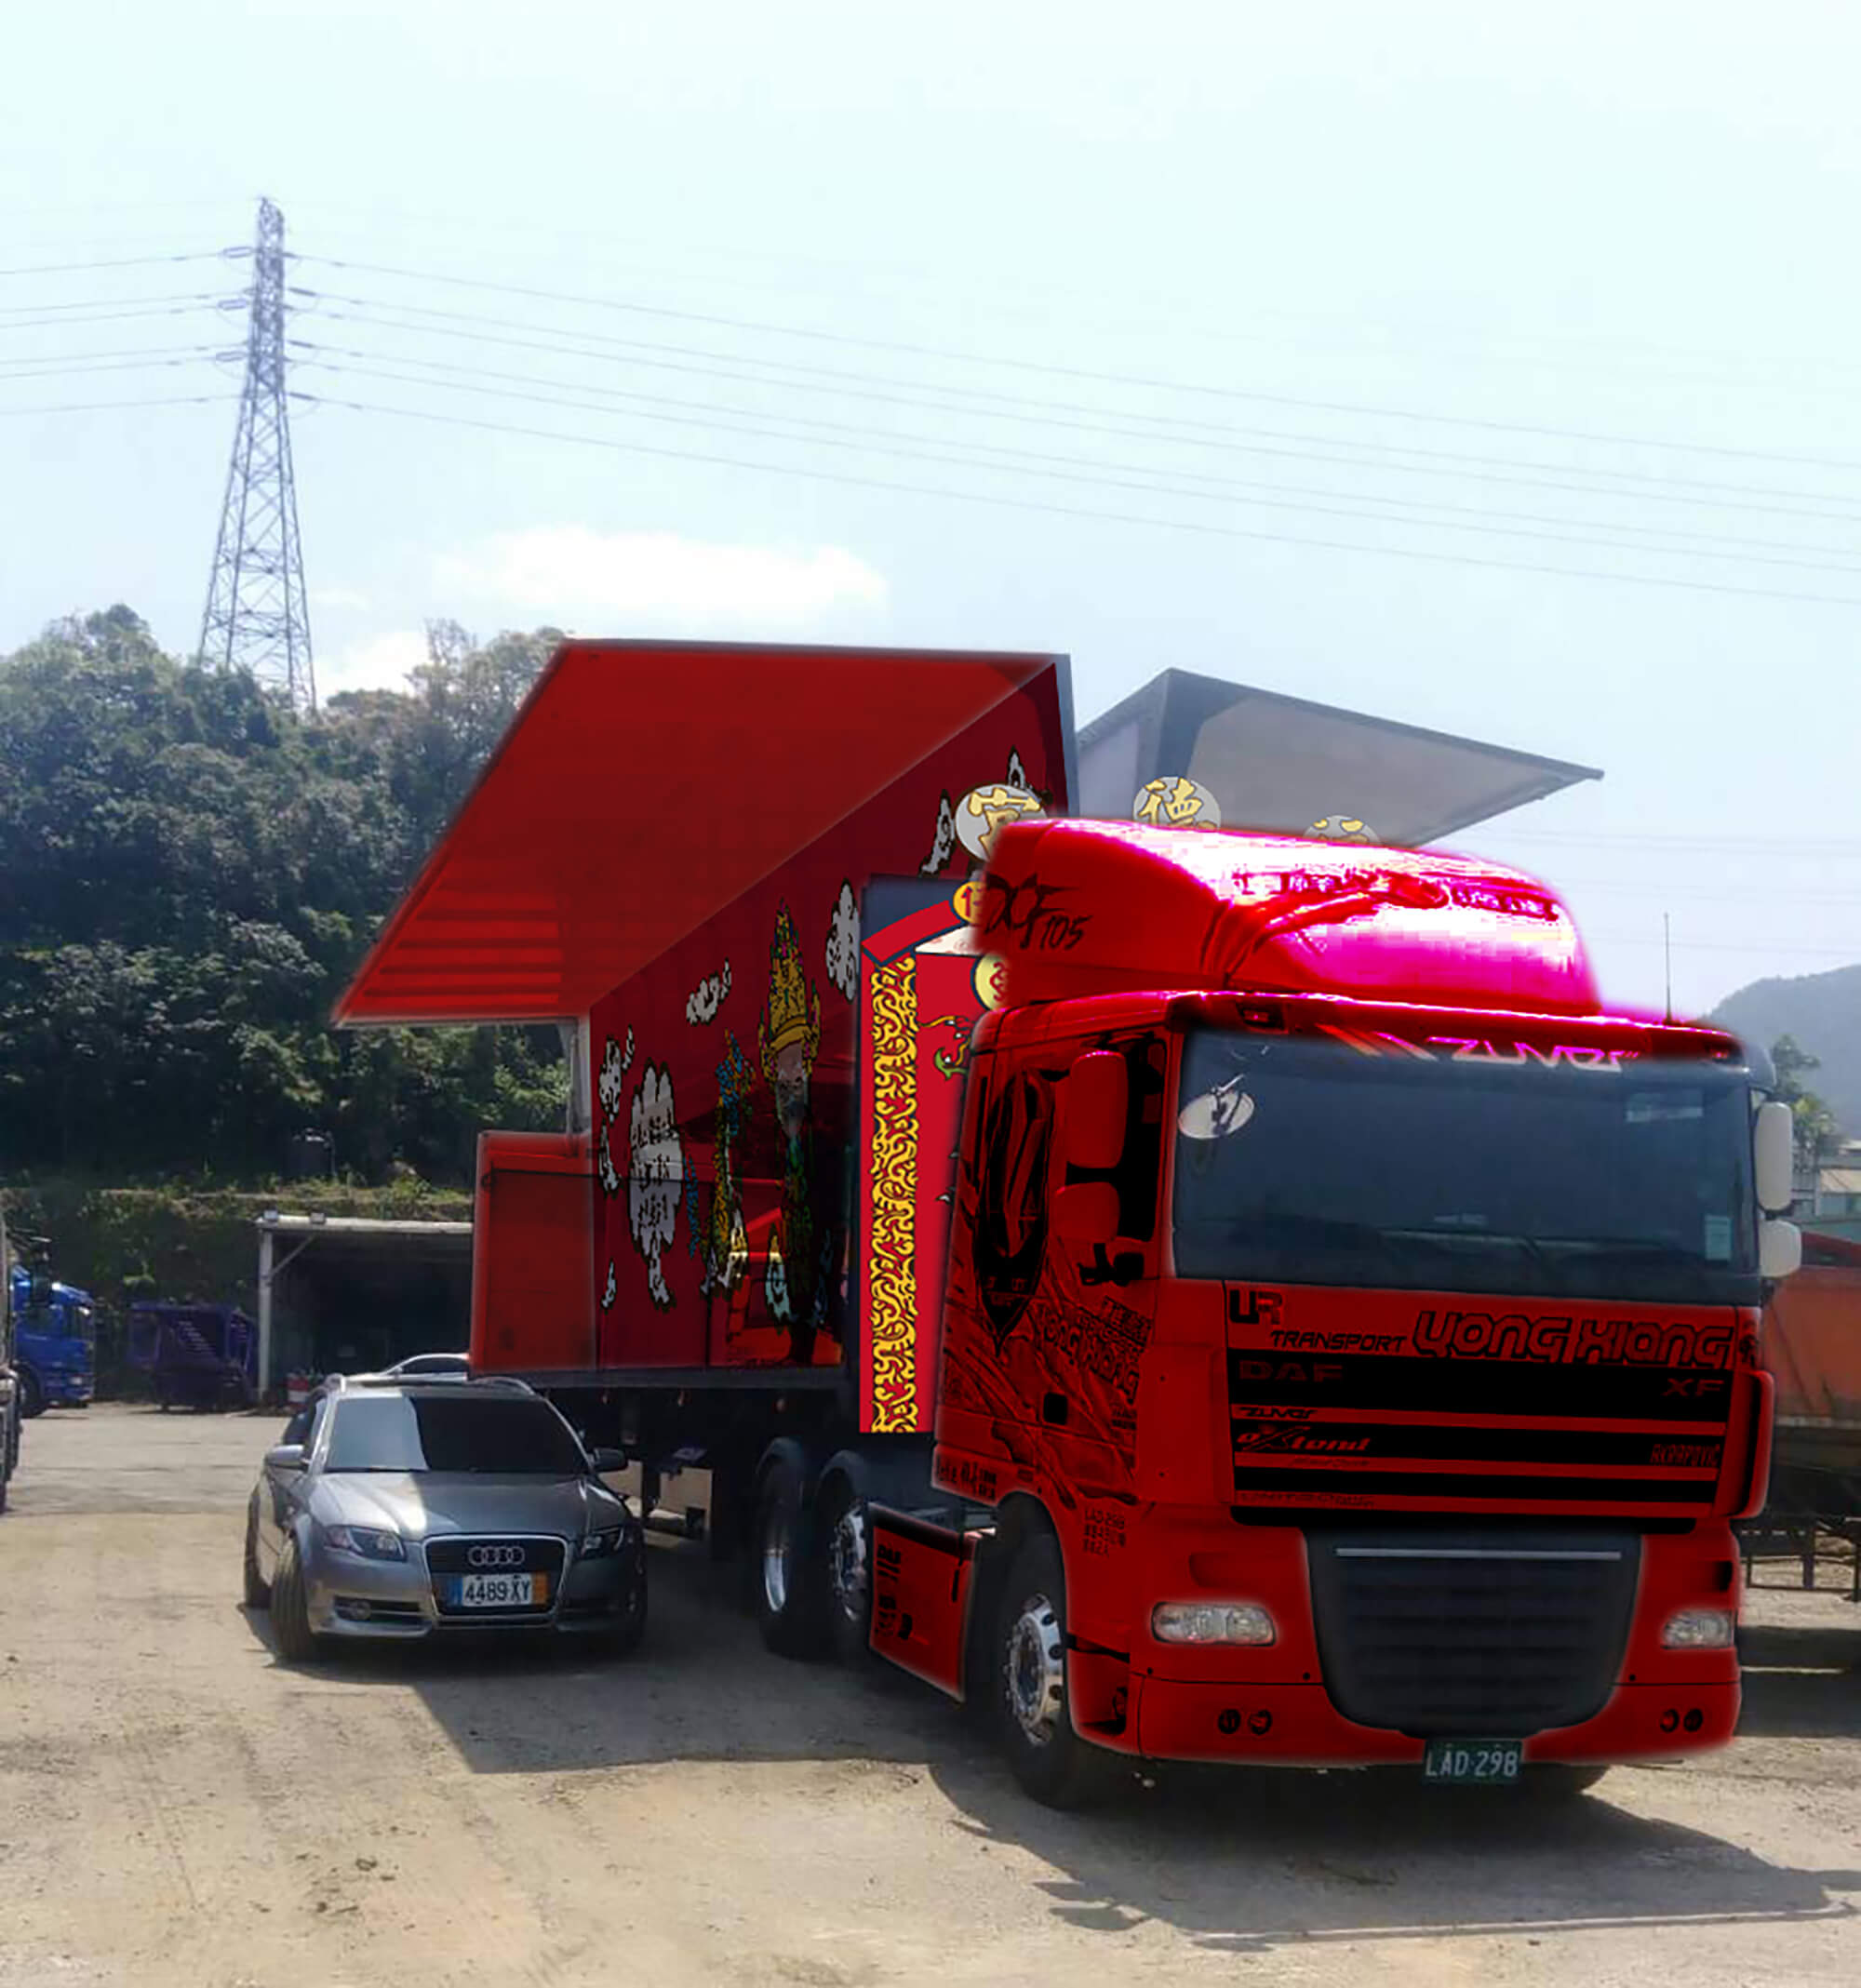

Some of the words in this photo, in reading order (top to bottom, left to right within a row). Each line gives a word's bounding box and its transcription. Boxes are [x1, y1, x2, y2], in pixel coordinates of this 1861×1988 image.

[1038, 914, 1093, 951] 105
[1270, 1329, 1407, 1353] TRANSPORT
[1238, 1360, 1344, 1382] DAF
[1661, 1378, 1725, 1396] XF
